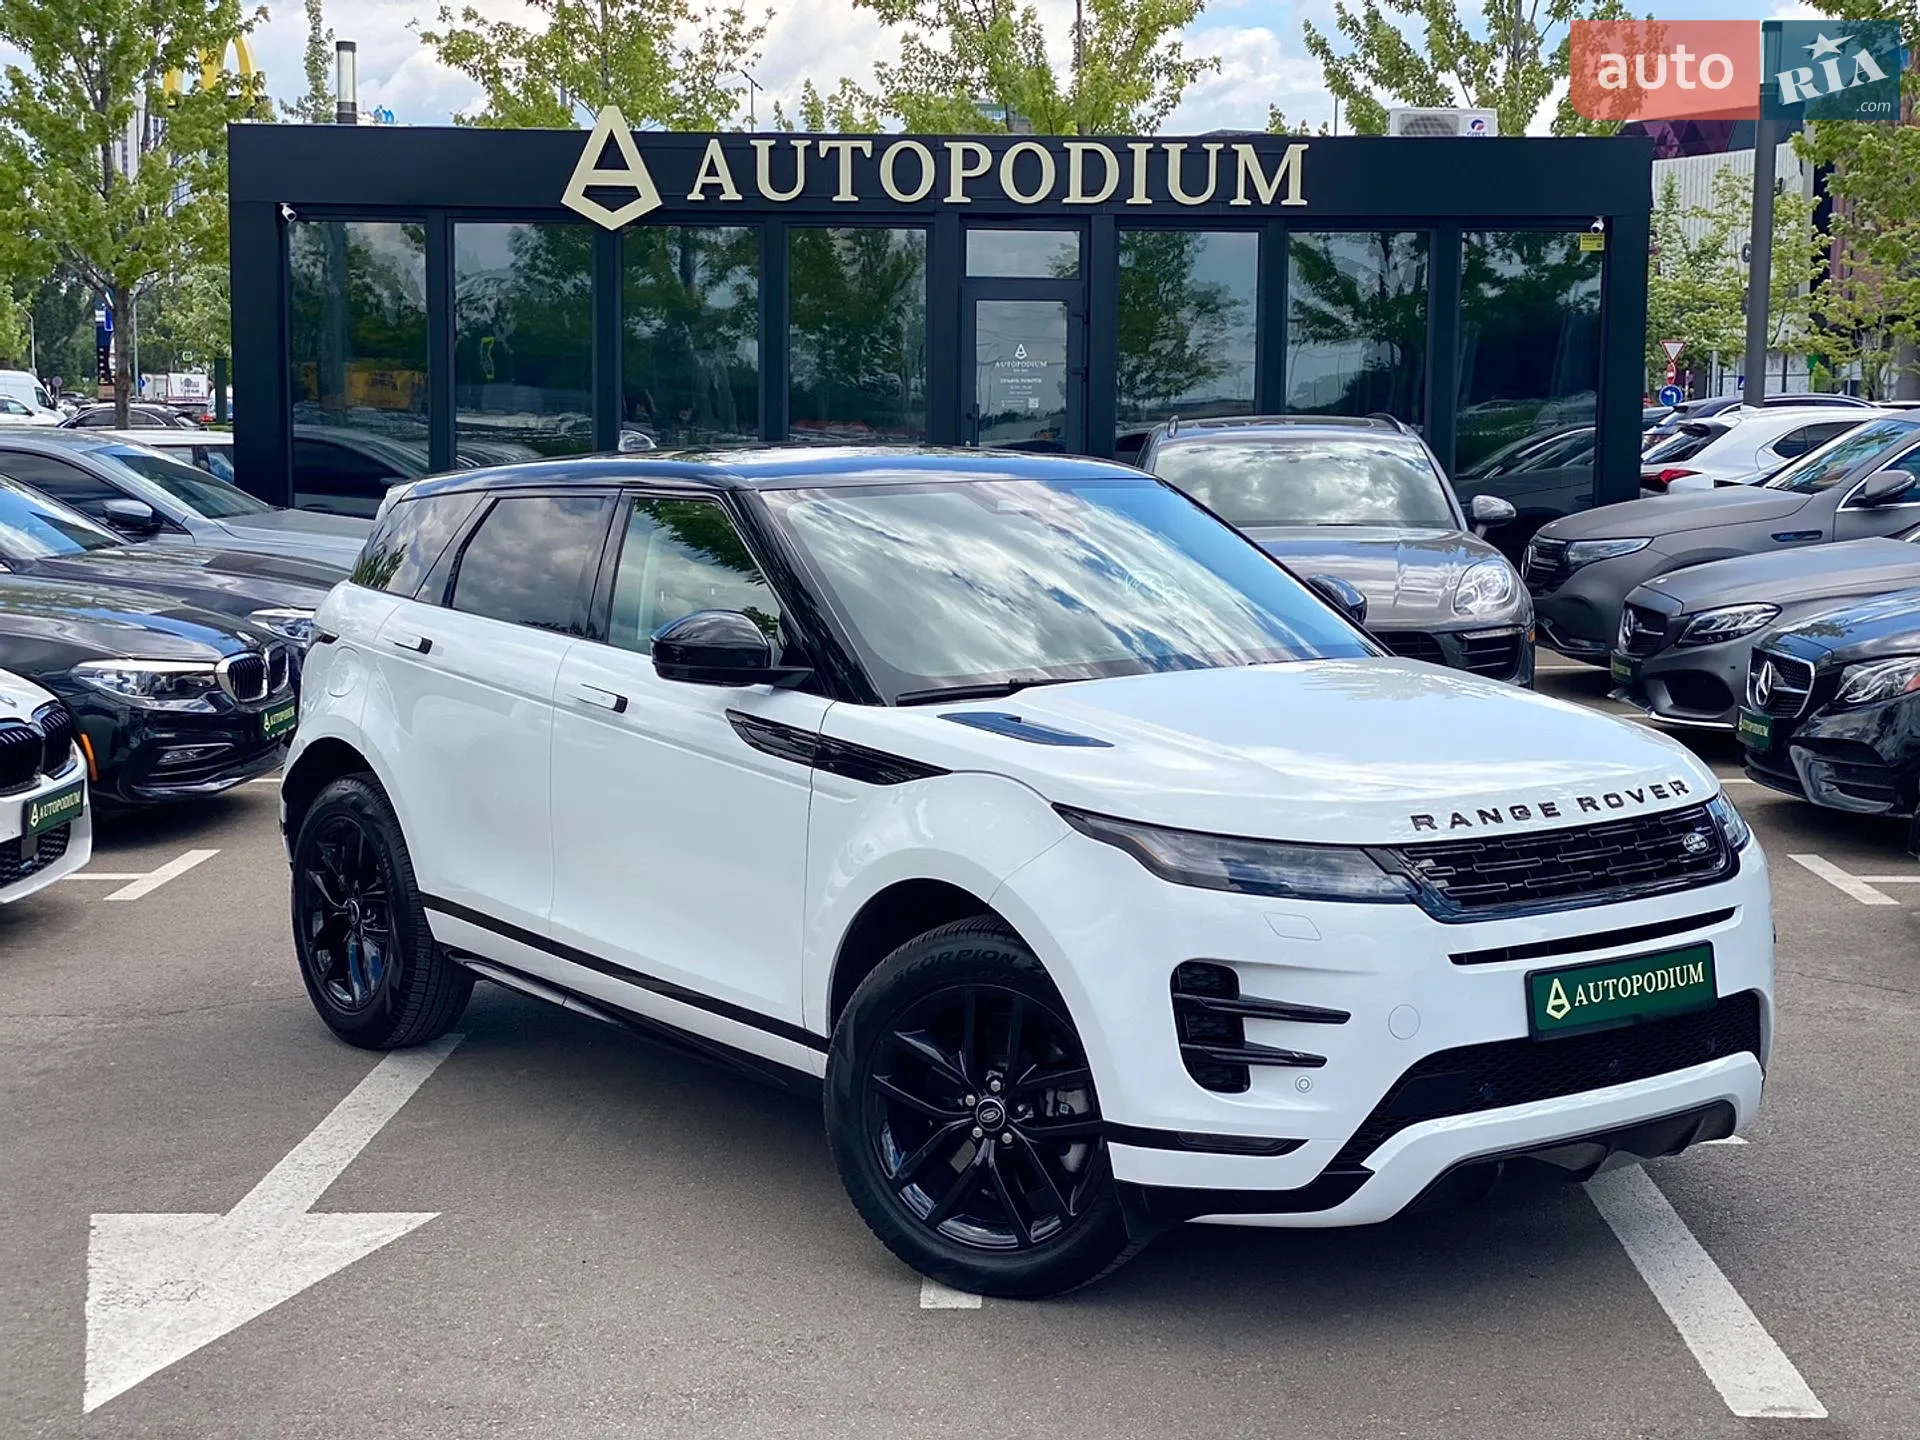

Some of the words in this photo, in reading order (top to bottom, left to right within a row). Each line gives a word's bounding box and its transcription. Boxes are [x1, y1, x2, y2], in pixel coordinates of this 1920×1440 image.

[686, 138, 1310, 206] AUTOPODIUM
[1410, 801, 1562, 832] RANGE
[1576, 778, 1691, 814] ROVER
[1574, 961, 1705, 1006] AUTOPODIUM
